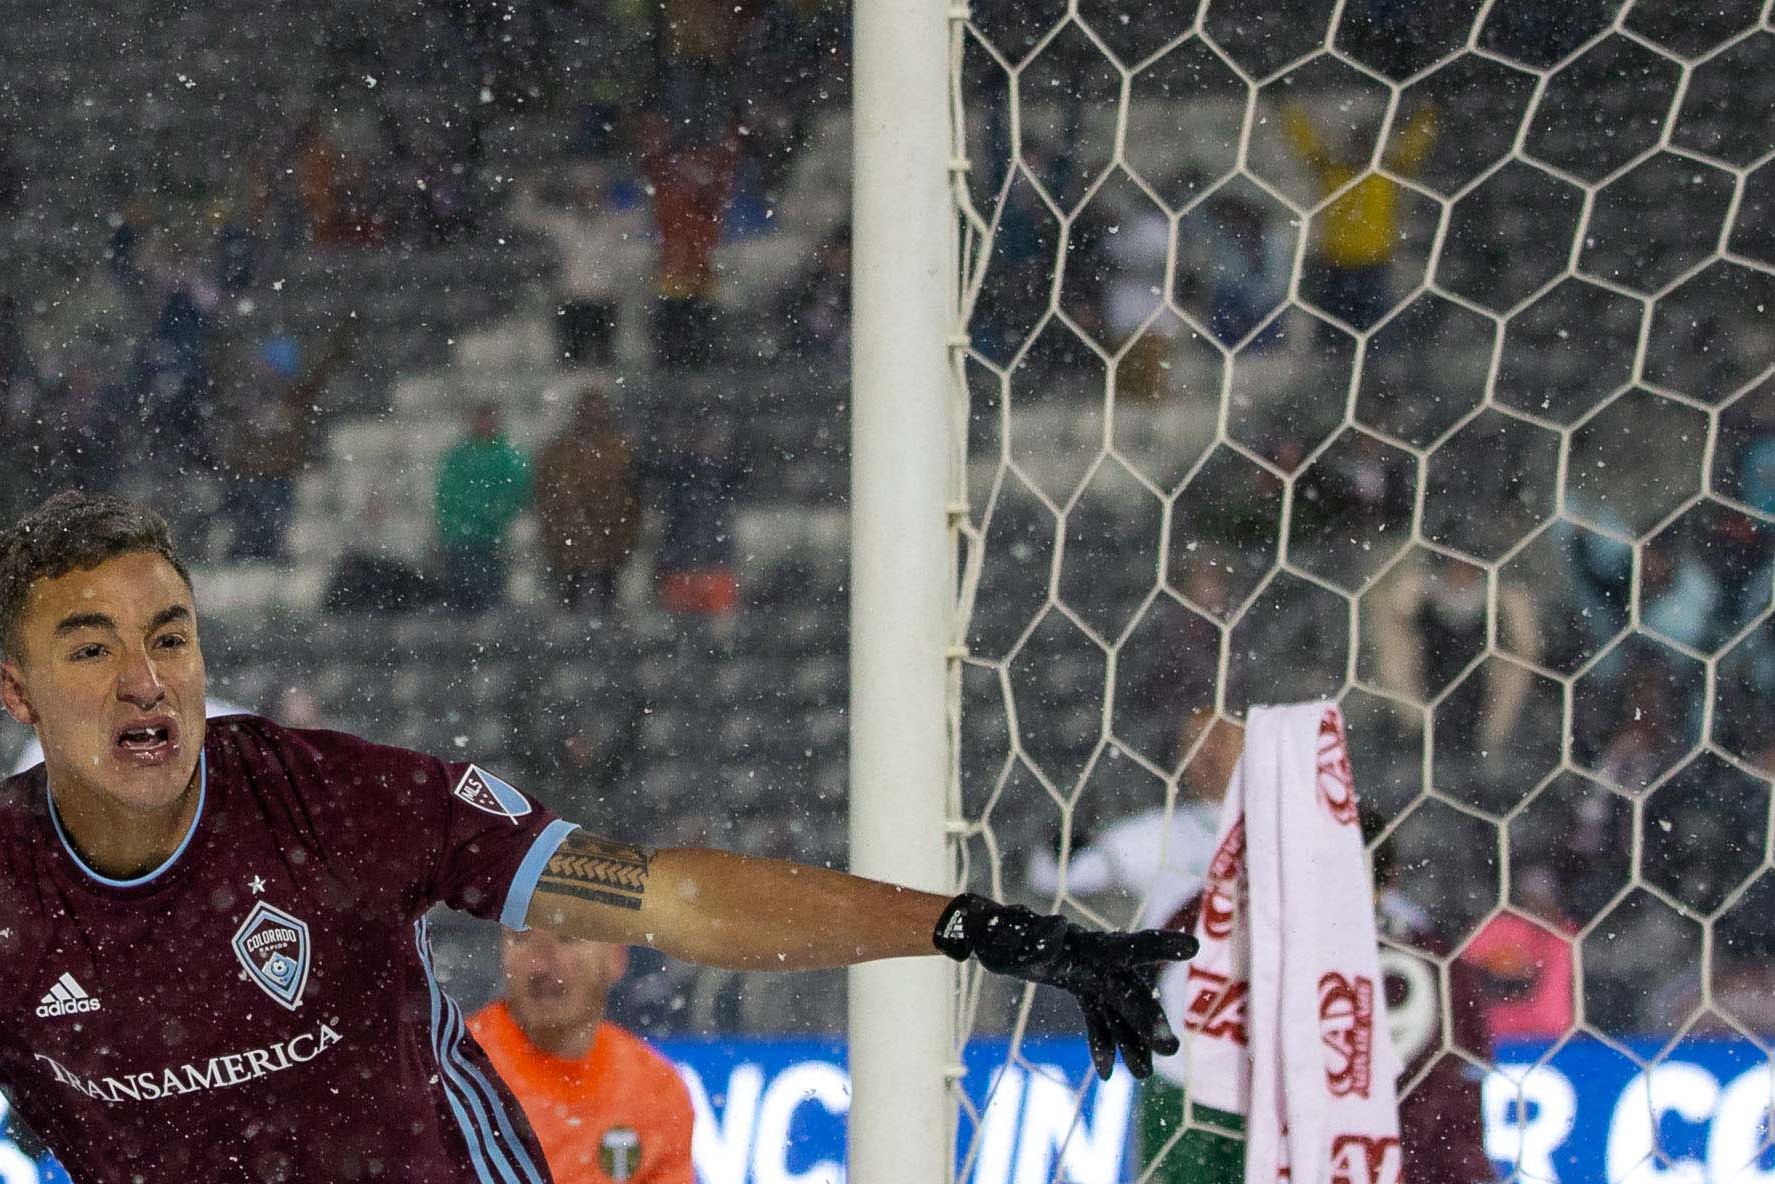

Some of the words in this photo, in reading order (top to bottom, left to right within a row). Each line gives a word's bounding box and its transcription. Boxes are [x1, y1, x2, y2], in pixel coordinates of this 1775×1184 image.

[461, 778, 482, 802] MLS
[246, 928, 297, 952] COLORADO
[35, 998, 101, 1018] adidas
[34, 1023, 343, 1102] TRANSAMERICA
